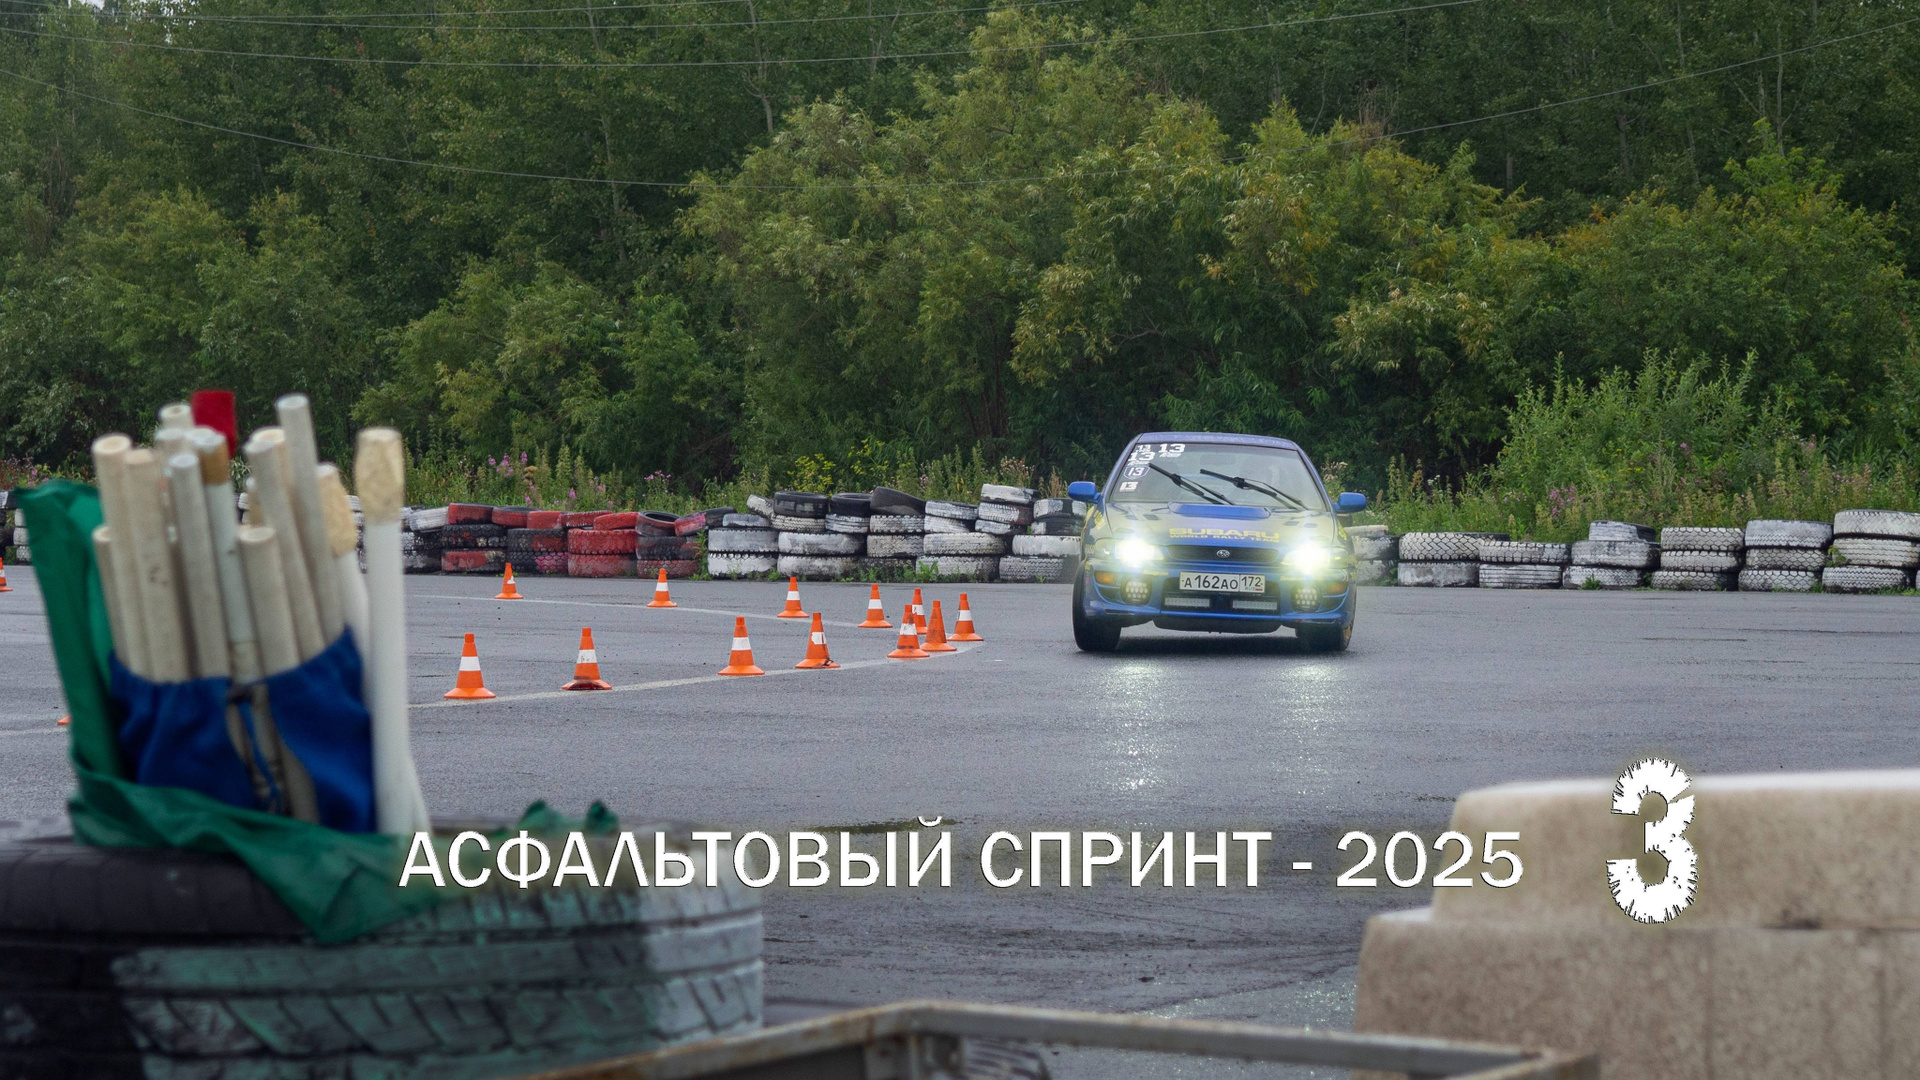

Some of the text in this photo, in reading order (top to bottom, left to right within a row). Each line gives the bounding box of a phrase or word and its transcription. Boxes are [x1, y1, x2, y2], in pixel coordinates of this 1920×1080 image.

[1158, 443, 1186, 453] 13
[1128, 450, 1155, 461] 13
[1128, 467, 1145, 476] 13
[1169, 528, 1280, 539] SUBARU
[1241, 576, 1262, 588] 172
